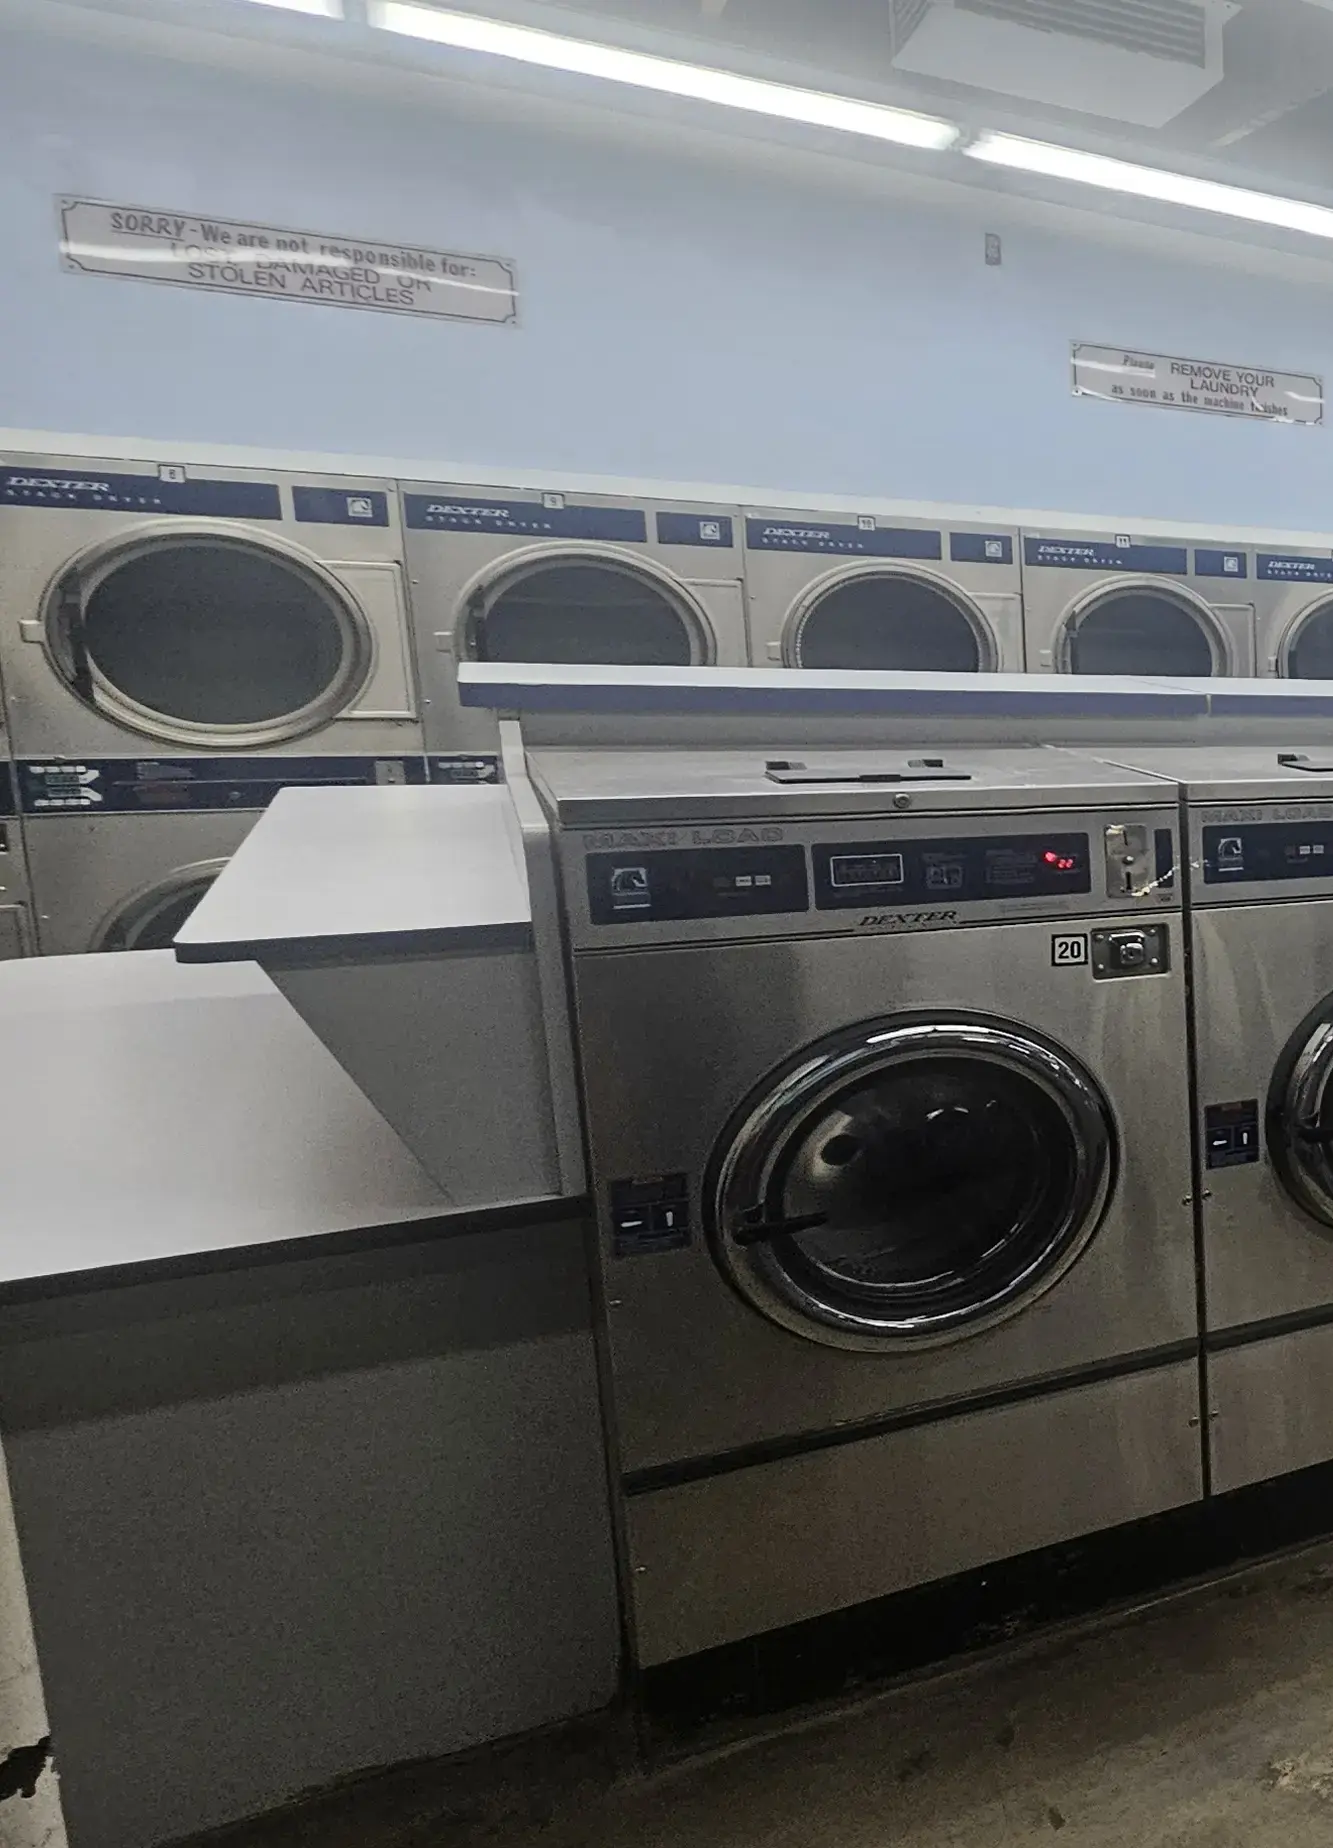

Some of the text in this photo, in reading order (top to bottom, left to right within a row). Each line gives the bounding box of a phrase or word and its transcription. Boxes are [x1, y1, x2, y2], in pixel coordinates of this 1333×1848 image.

[111, 212, 186, 238] SORRY
[200, 223, 232, 244] We
[237, 233, 269, 249] are
[276, 237, 308, 252] not
[319, 243, 440, 273] responsible
[442, 256, 476, 277] for:
[188, 262, 415, 305] STOLEN ARTICLES
[1170, 361, 1231, 382] REMOVE
[1236, 371, 1275, 388] YOUR
[1111, 384, 1124, 395] as
[1130, 387, 1156, 399] soon
[1162, 391, 1175, 402] as
[1181, 390, 1198, 405] the
[1204, 396, 1245, 410] machine
[1190, 378, 1258, 397] LAUNDRY
[6, 476, 111, 492] DEXTER
[426, 504, 511, 517] DEXTER
[763, 527, 830, 539] DEXTER
[1038, 545, 1094, 556] DEXTER
[859, 910, 957, 927] DEXTER
[1058, 940, 1082, 959] 20
